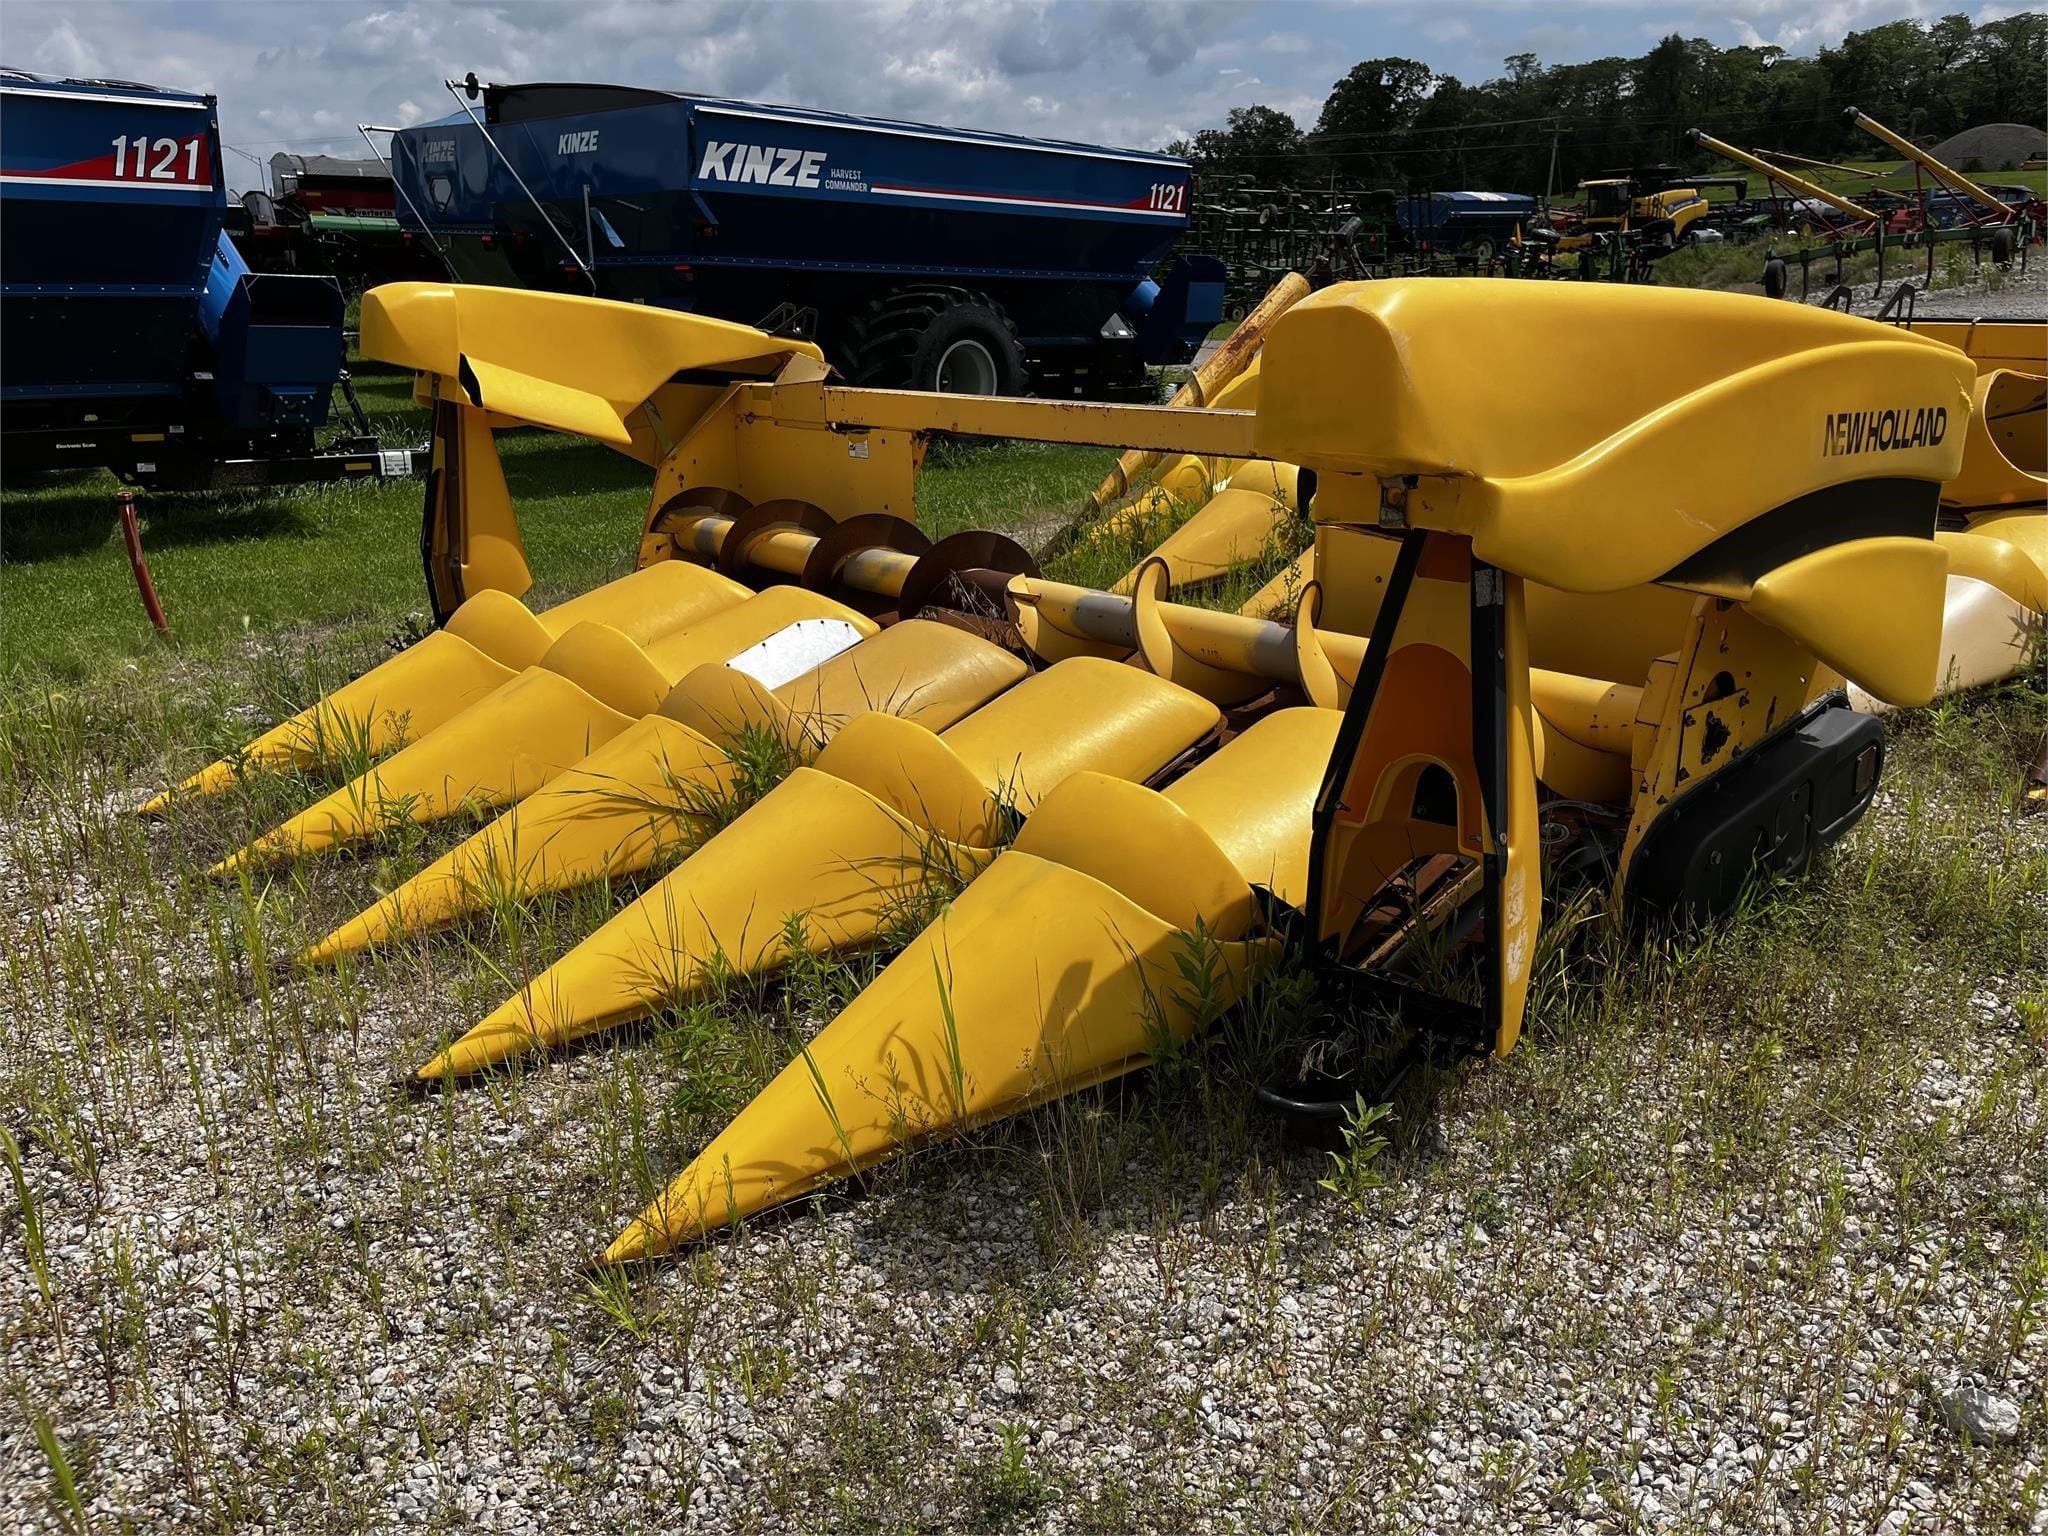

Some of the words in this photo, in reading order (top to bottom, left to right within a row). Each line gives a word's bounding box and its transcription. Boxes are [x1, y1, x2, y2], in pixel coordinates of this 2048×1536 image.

[558, 130, 600, 155] KINZE
[111, 135, 199, 180] 1121
[698, 141, 828, 189] KINZE
[825, 180, 868, 193] COMMANDER
[830, 168, 862, 180] HARVEST
[1150, 183, 1184, 211] 1121
[1823, 412, 1867, 457] NEW
[1865, 407, 1947, 452] HOLLAND
